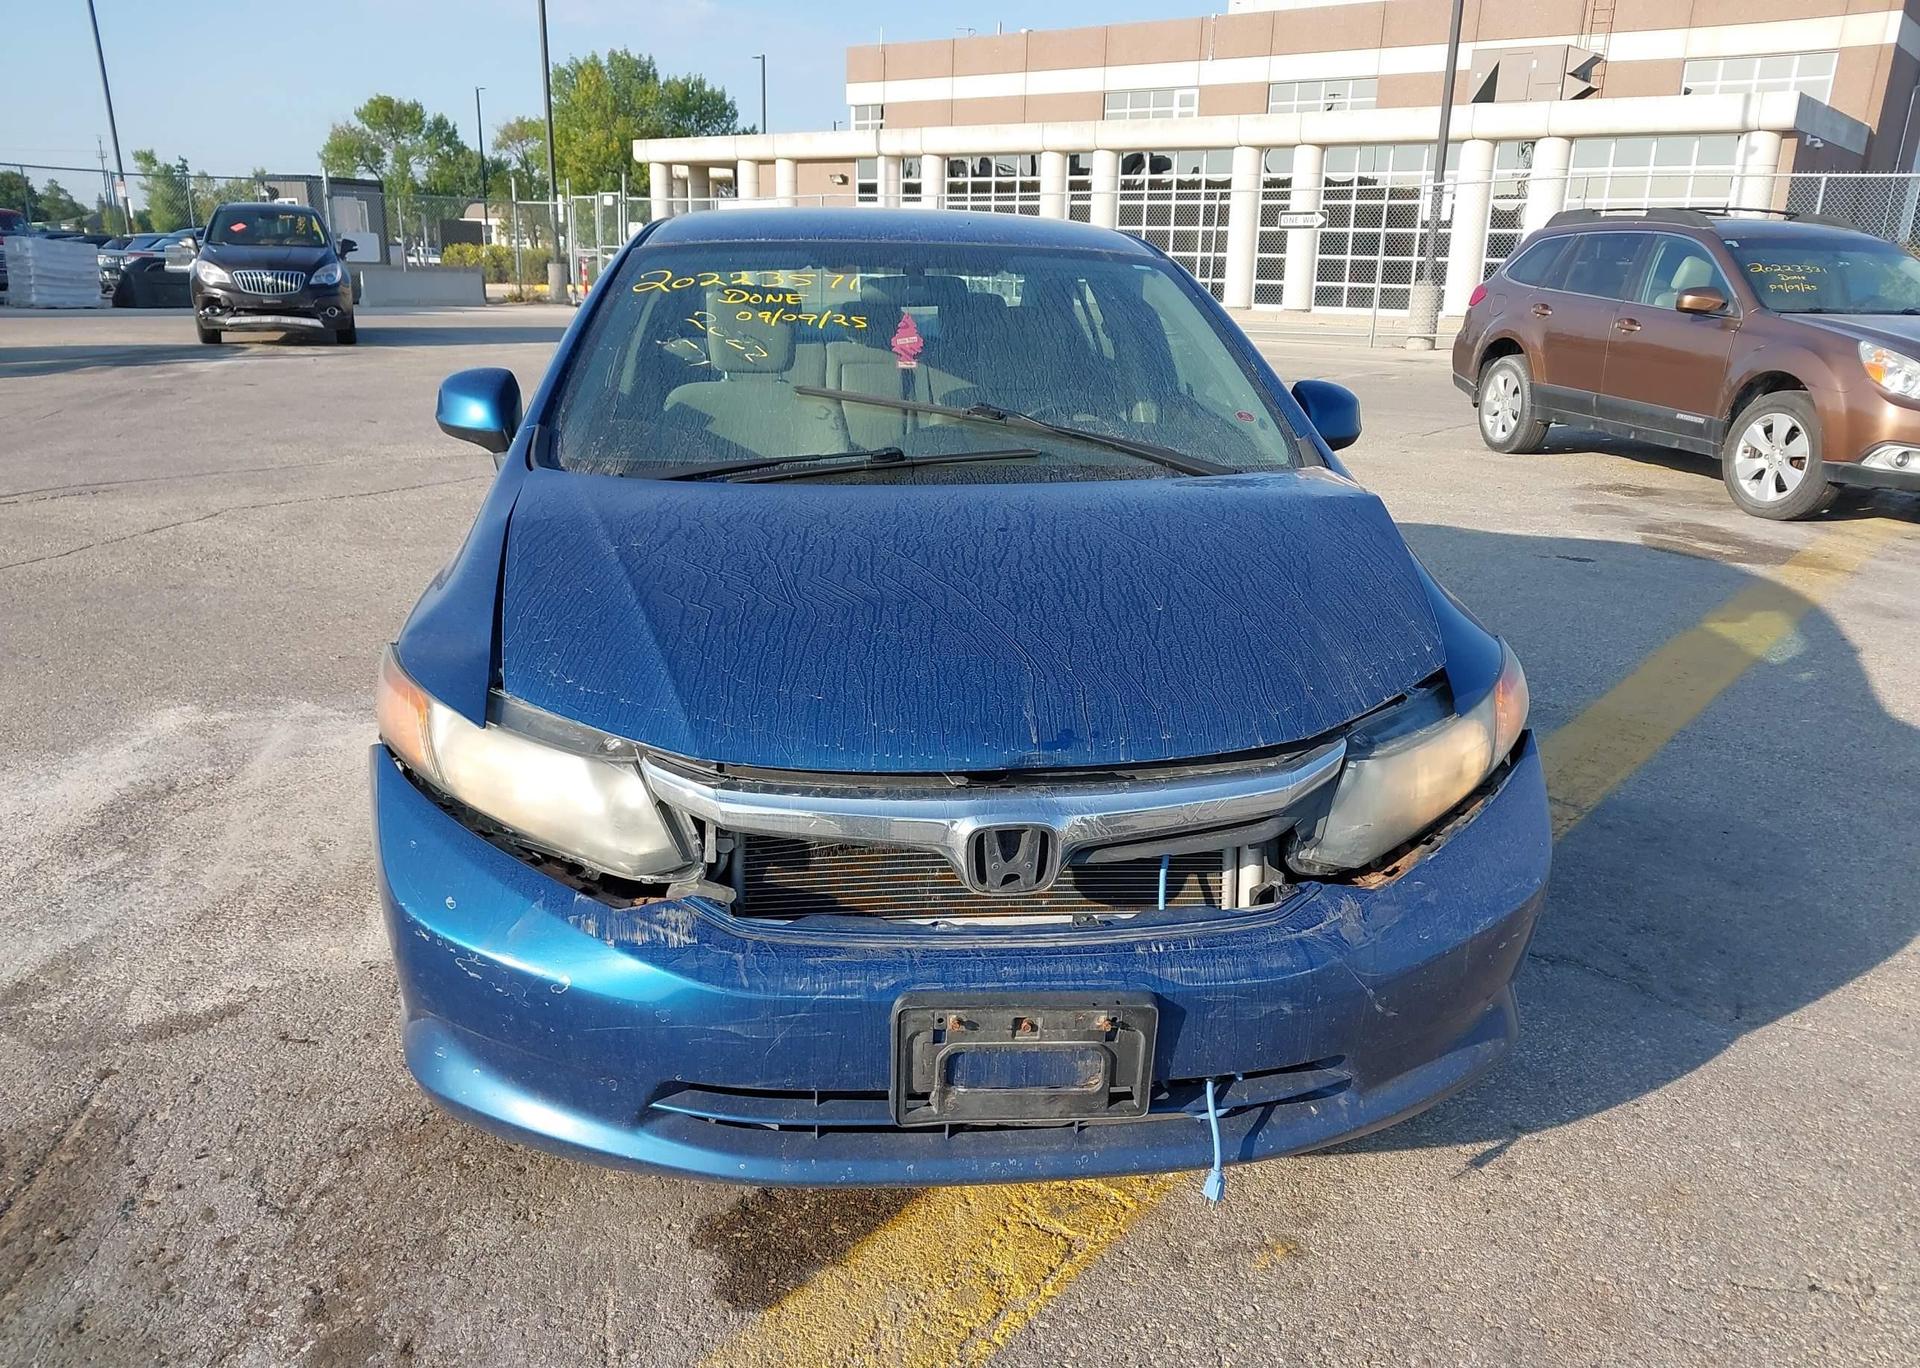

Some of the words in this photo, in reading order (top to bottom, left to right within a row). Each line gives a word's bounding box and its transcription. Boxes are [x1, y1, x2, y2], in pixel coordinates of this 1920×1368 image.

[1282, 216, 1300, 224] ONE
[1302, 215, 1320, 224] WAY
[717, 288, 810, 304] DONE
[735, 308, 868, 330] 09/09/25
